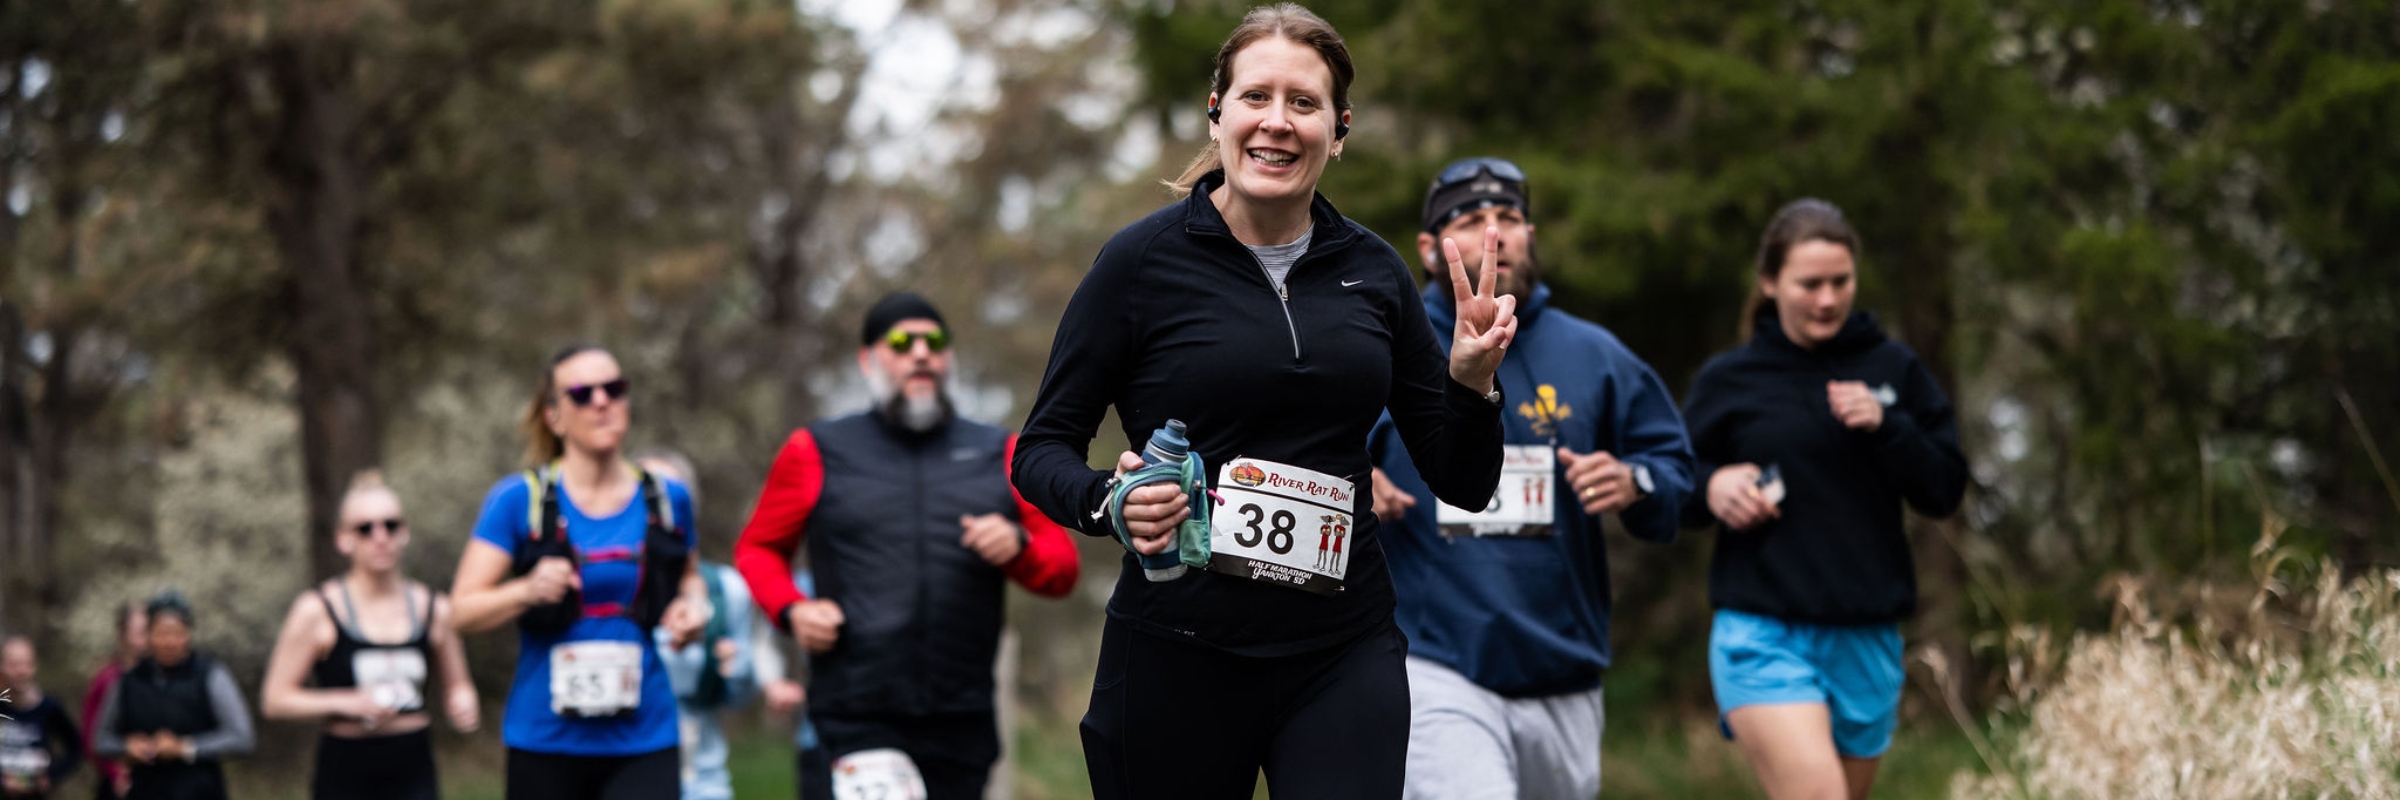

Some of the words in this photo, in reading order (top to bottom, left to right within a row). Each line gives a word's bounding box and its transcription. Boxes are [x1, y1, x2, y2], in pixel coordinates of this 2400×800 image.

[1268, 473, 1304, 492] RIVER
[1306, 481, 1328, 496] RAT
[1329, 487, 1349, 501] RUN
[1234, 503, 1296, 555] 38
[1248, 560, 1270, 569] HALF
[1270, 565, 1313, 580] MARATHON
[1252, 568, 1291, 581] YANKTON
[1293, 577, 1305, 585] SD
